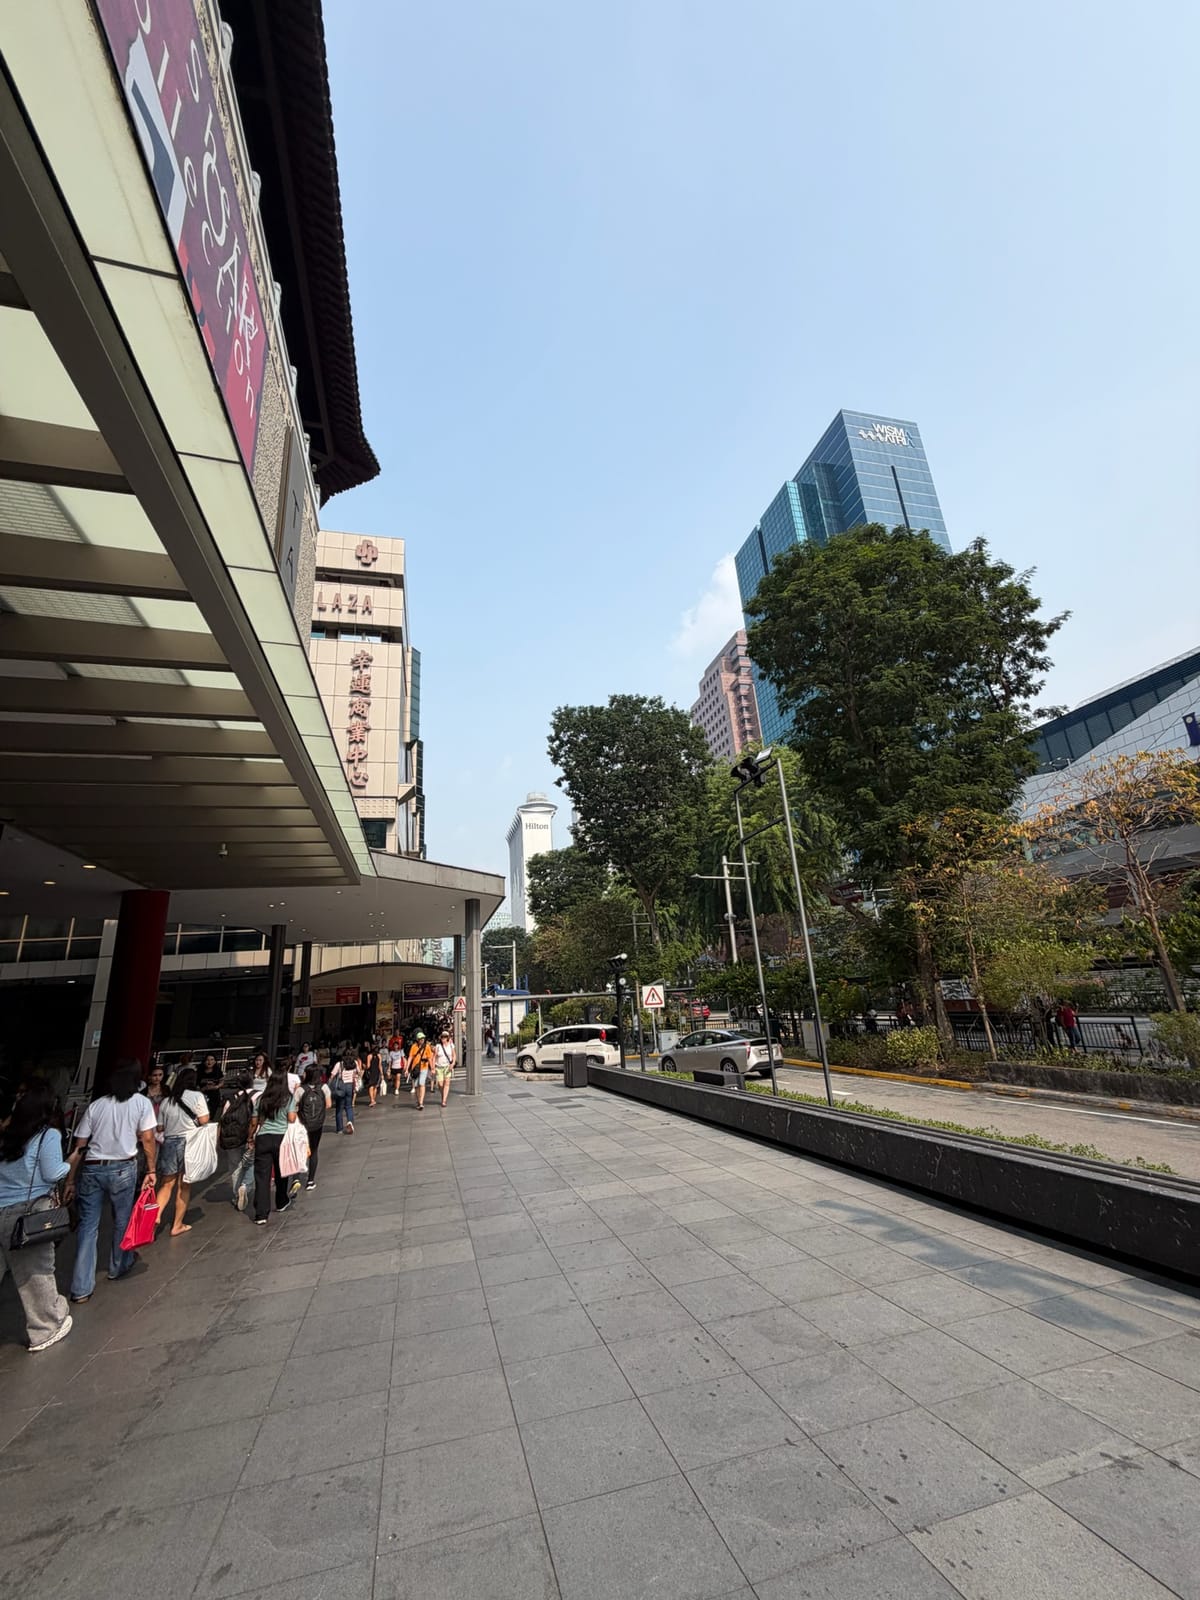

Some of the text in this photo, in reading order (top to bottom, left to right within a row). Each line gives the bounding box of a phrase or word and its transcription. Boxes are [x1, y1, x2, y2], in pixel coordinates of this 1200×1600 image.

[346, 649, 373, 786] 幸運商業中心
[525, 822, 549, 830] Hilton
